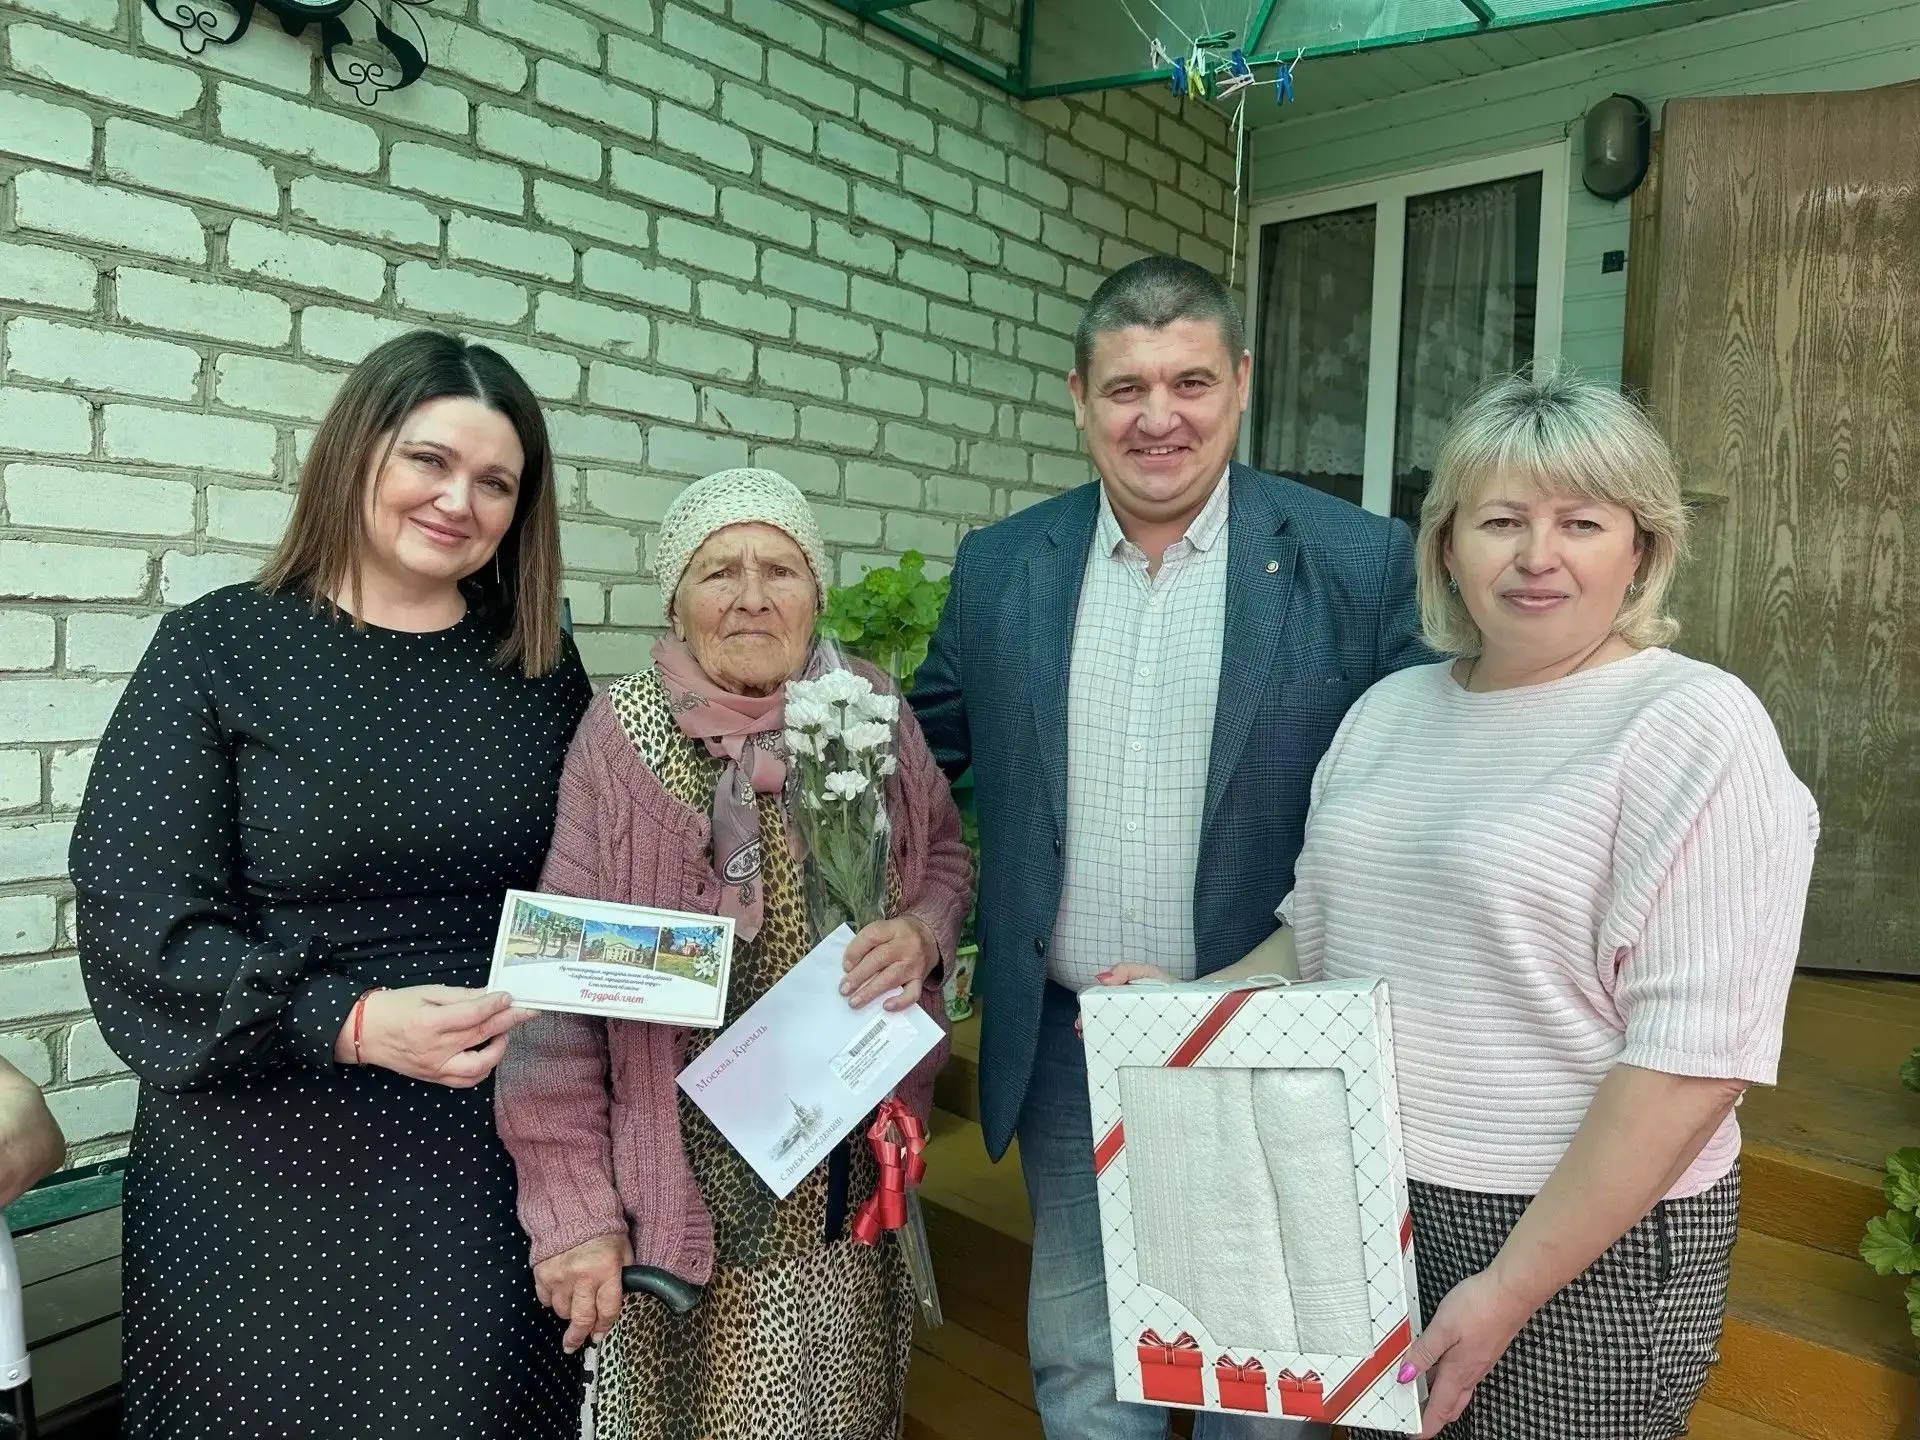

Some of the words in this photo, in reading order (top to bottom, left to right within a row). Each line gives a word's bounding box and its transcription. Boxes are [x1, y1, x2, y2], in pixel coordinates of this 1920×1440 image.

[580, 988, 644, 1004] Поздравляет
[732, 1025, 768, 1058] Кремль
[780, 1173, 788, 1181] С
[785, 1155, 807, 1175] ДНЕМ
